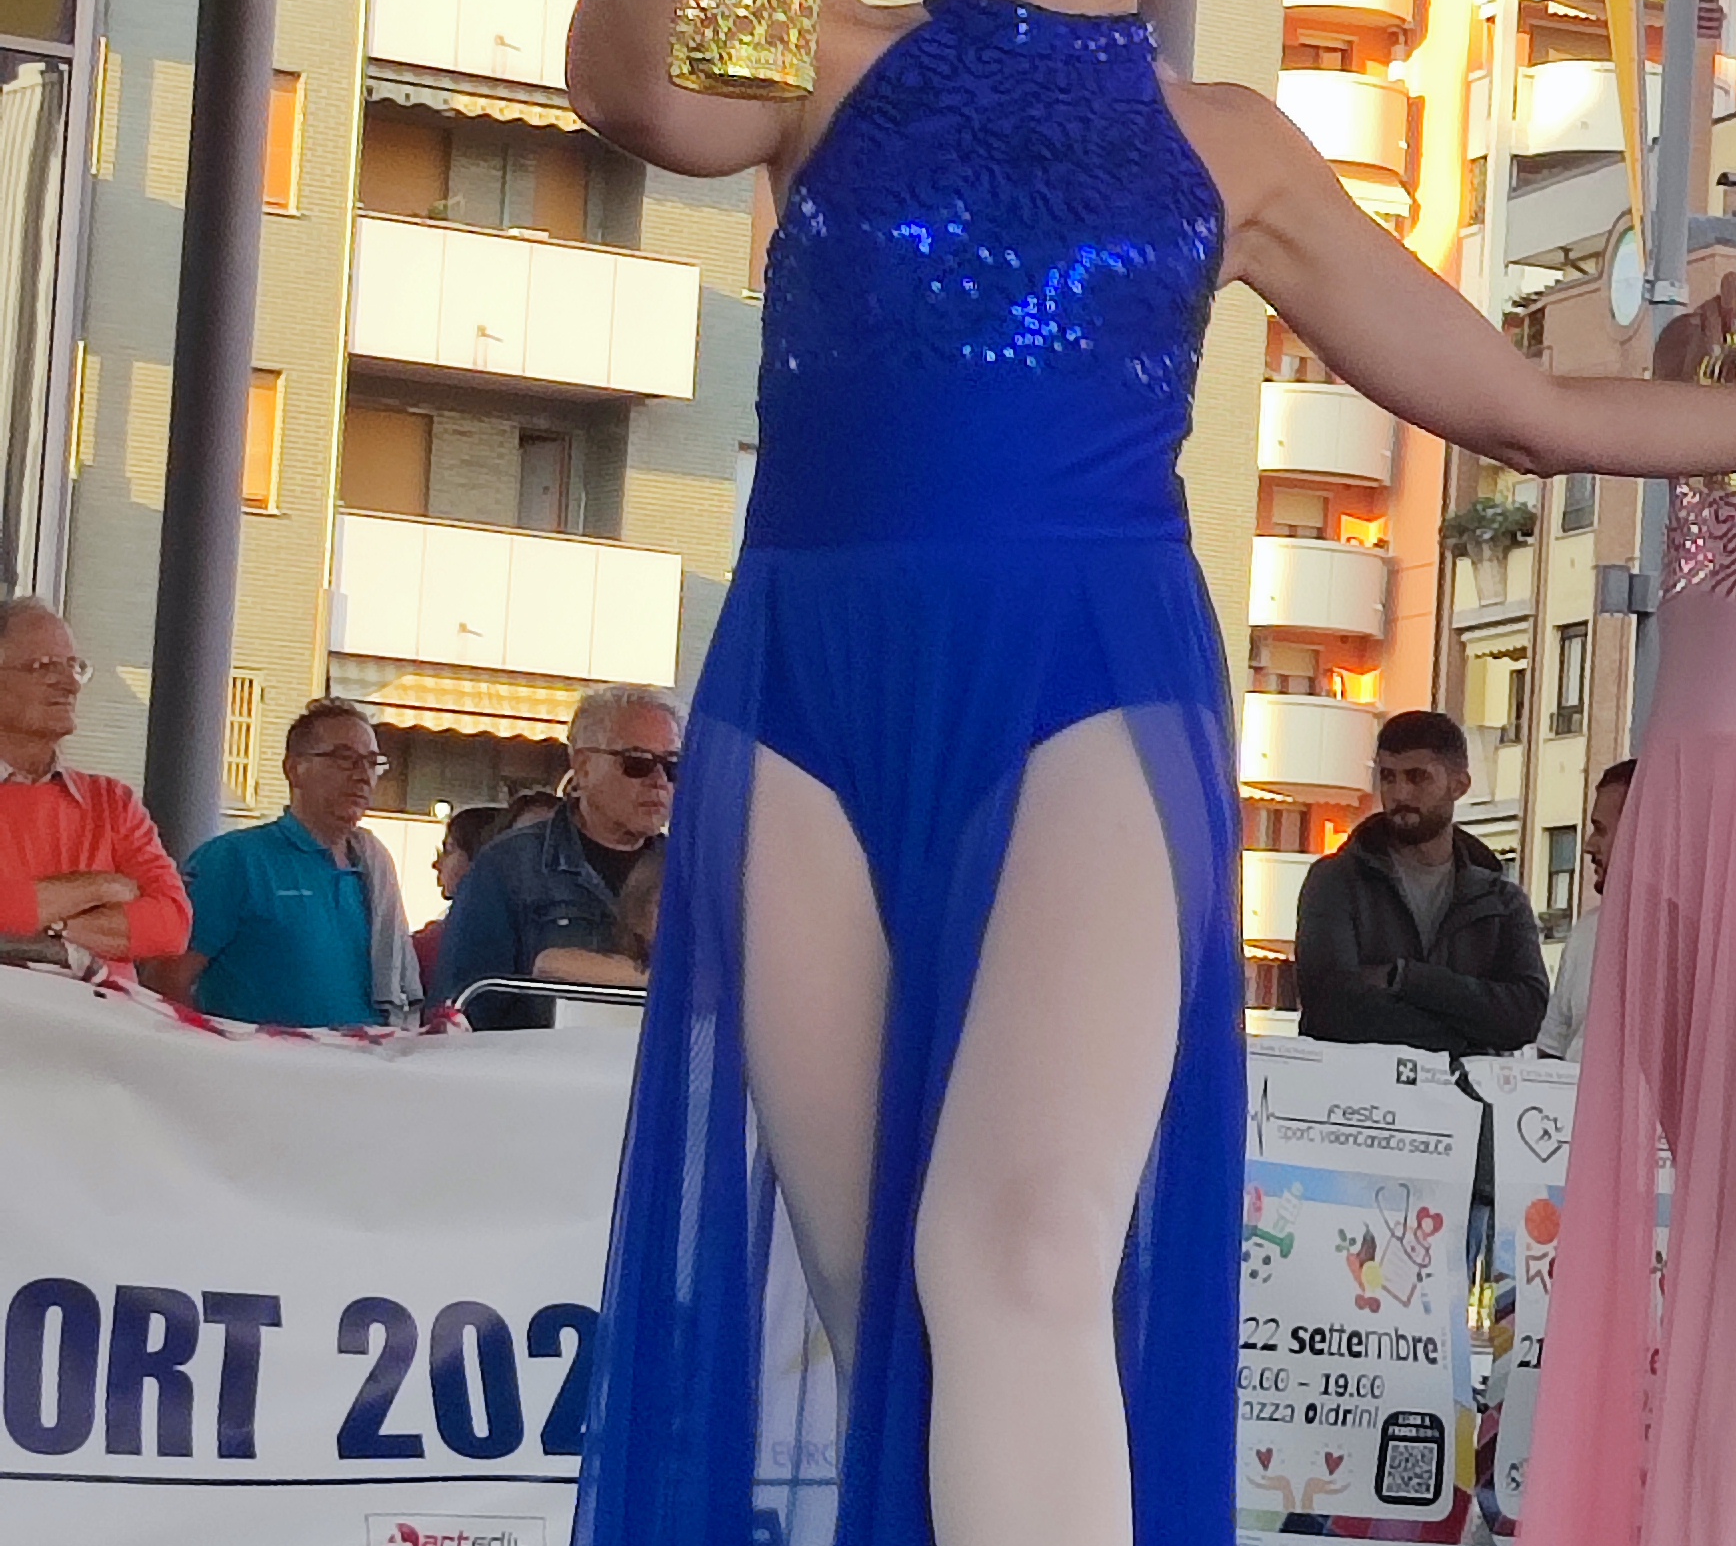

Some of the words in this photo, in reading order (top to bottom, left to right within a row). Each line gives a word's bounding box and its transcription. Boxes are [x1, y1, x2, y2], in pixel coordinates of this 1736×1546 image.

[1239, 1316, 1280, 1352] 22
[1287, 1321, 1440, 1366] settembre
[2, 1276, 284, 1460] ORT
[336, 1295, 603, 1460] 202
[1319, 1372, 1386, 1399] 19.00
